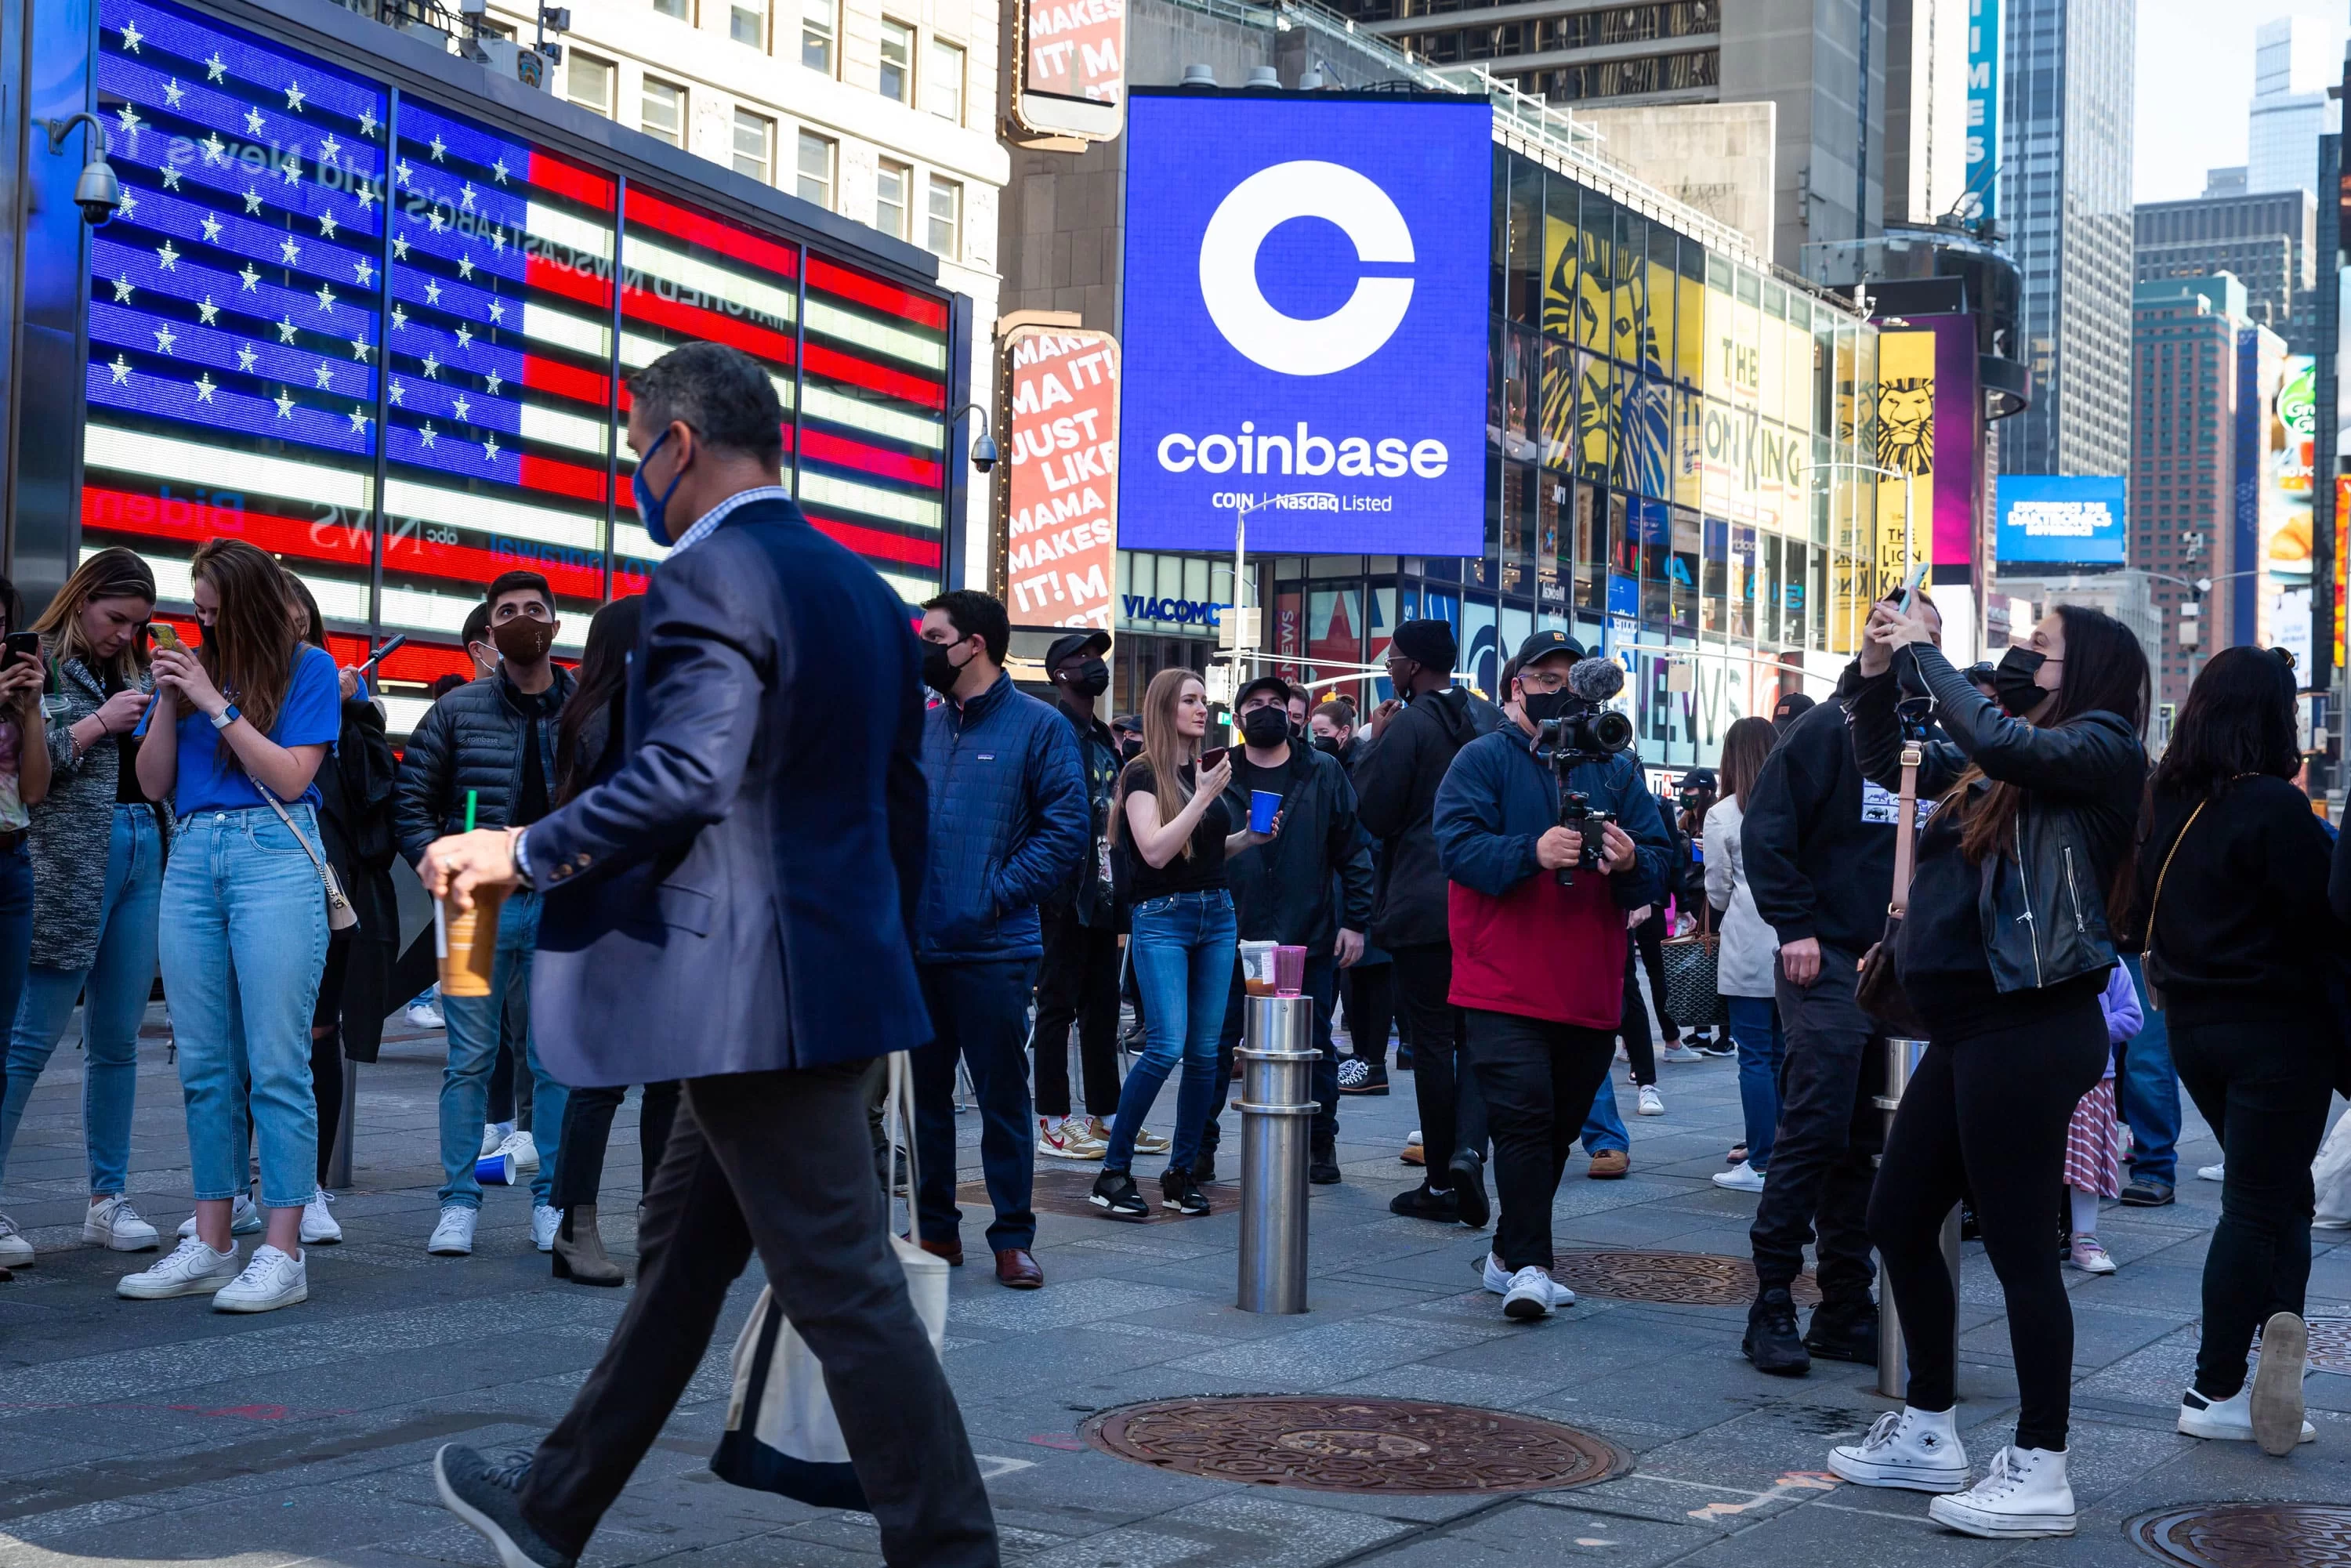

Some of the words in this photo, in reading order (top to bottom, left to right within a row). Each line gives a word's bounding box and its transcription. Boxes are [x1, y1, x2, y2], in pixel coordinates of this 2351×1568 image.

[1067, 349, 1116, 391] IT!
[1722, 337, 1757, 388] THE
[1010, 407, 1099, 465] JUST
[1157, 421, 1449, 479] coinbase
[1009, 487, 1107, 539] MAMA
[1212, 492, 1254, 509] COIN
[1275, 493, 1339, 513] Nasdaq
[1342, 494, 1393, 512] Listed
[1008, 518, 1112, 575] MAKES
[1013, 570, 1066, 614] IT!
[1121, 594, 1248, 626] VIACOMC
[1281, 610, 1295, 672] NEWS
